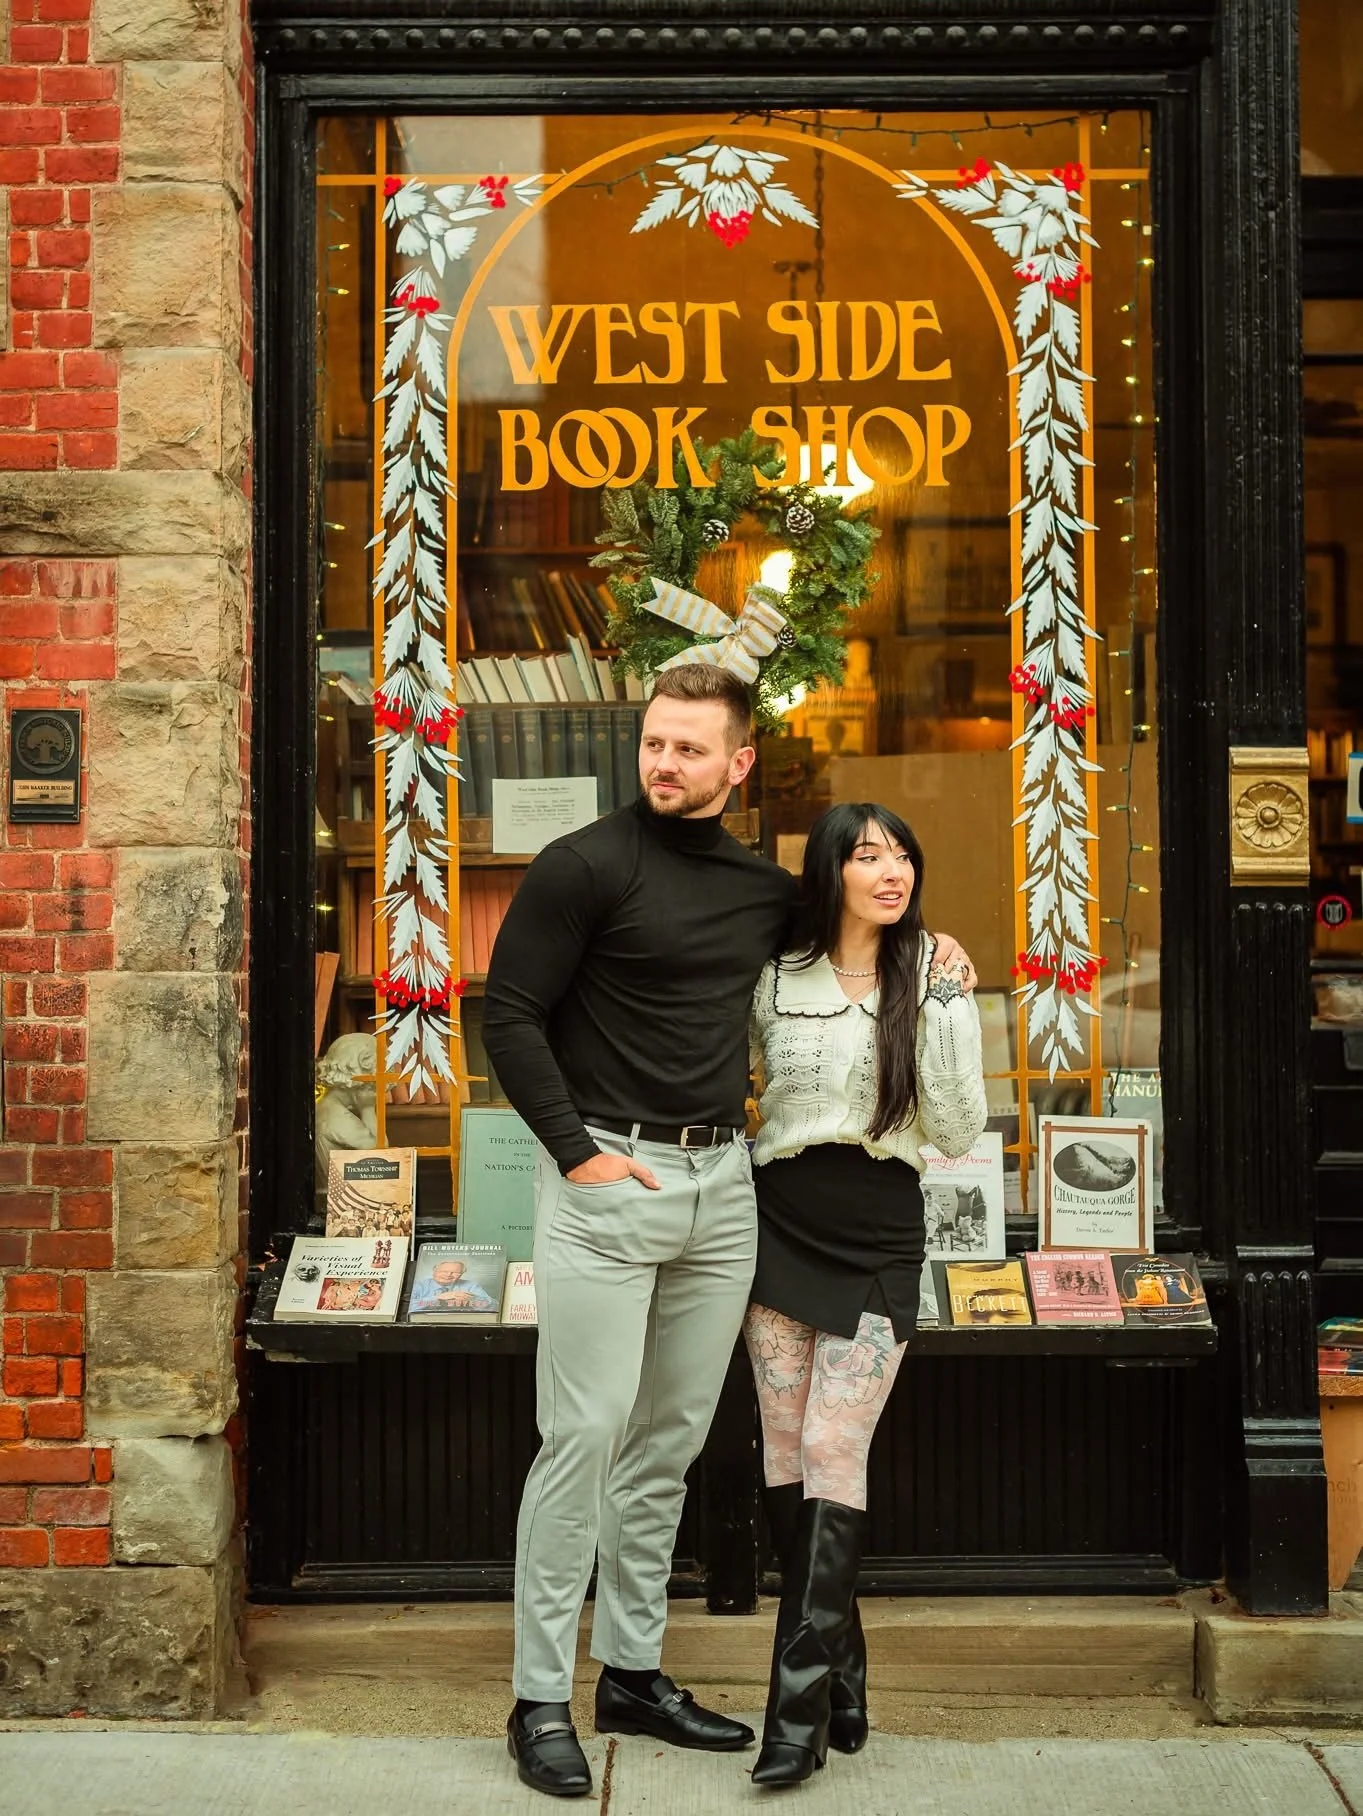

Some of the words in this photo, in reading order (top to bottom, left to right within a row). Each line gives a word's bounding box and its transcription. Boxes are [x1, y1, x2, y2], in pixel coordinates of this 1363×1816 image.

[487, 301, 741, 385] WEST
[765, 300, 952, 384] SIDE
[498, 406, 717, 491] BOOK
[751, 404, 972, 489] SHOP
[485, 1164, 524, 1172] NATION'S
[960, 1154, 992, 1166] Poems
[1054, 1184, 1106, 1206] CHAUTAUQUA
[1108, 1187, 1136, 1204] GORGE
[953, 1294, 1028, 1312] BECKETT
